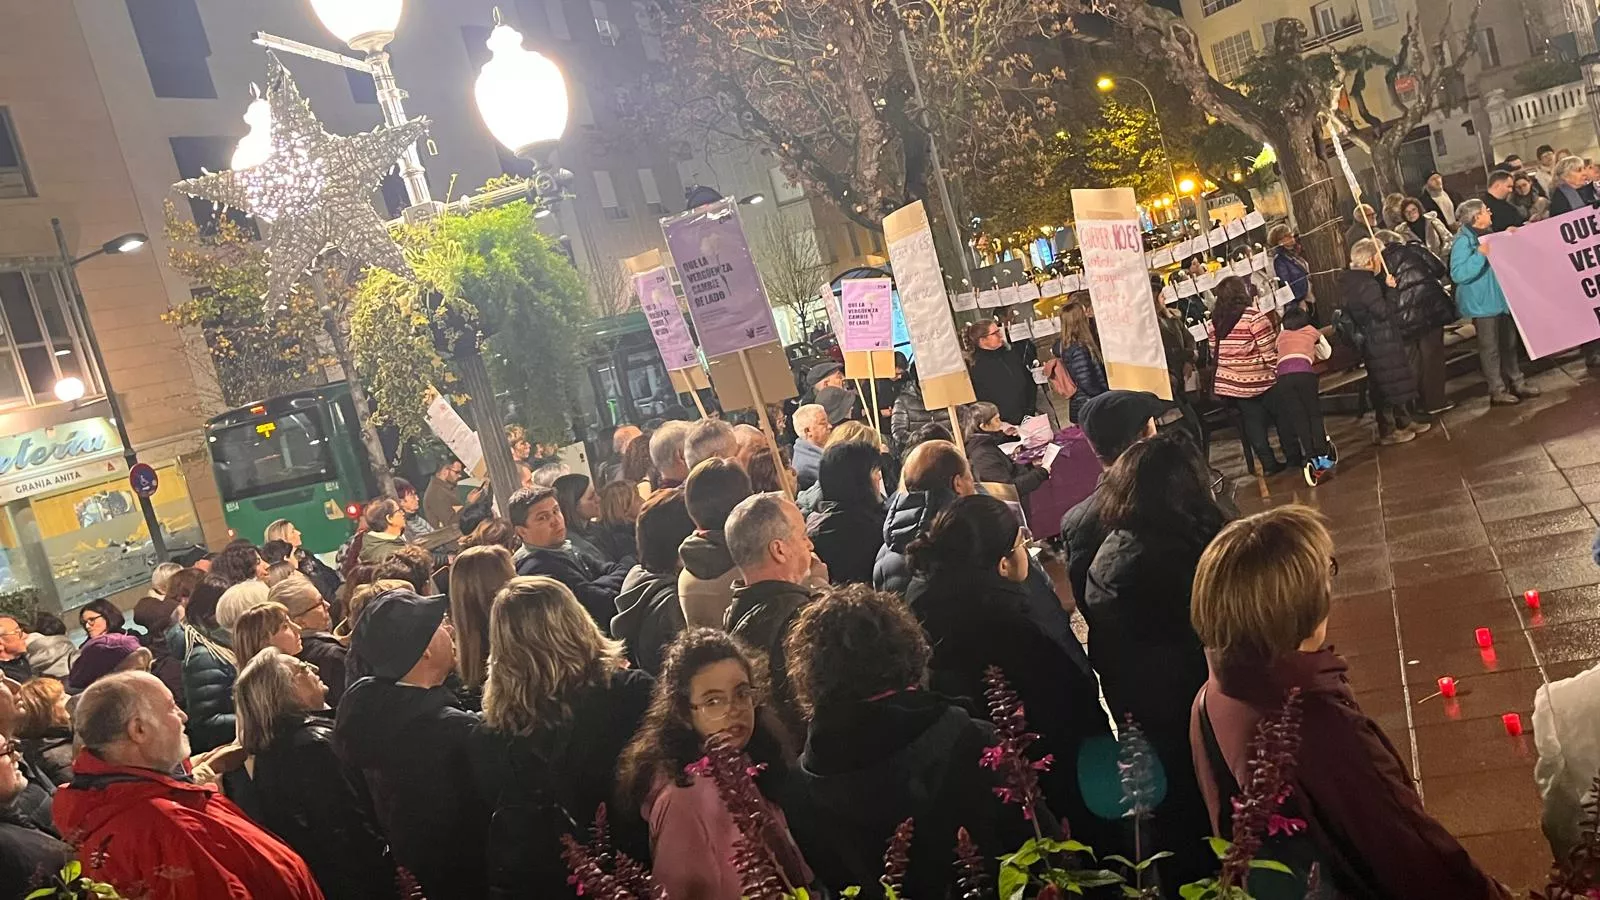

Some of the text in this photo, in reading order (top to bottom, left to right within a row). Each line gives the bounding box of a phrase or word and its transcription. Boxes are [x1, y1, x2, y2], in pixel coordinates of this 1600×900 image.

[682, 256, 709, 272] QUE LA
[691, 278, 720, 295] CAMBIE
[694, 290, 726, 308] DE LADO
[15, 471, 82, 494] GRANJA ANITA
